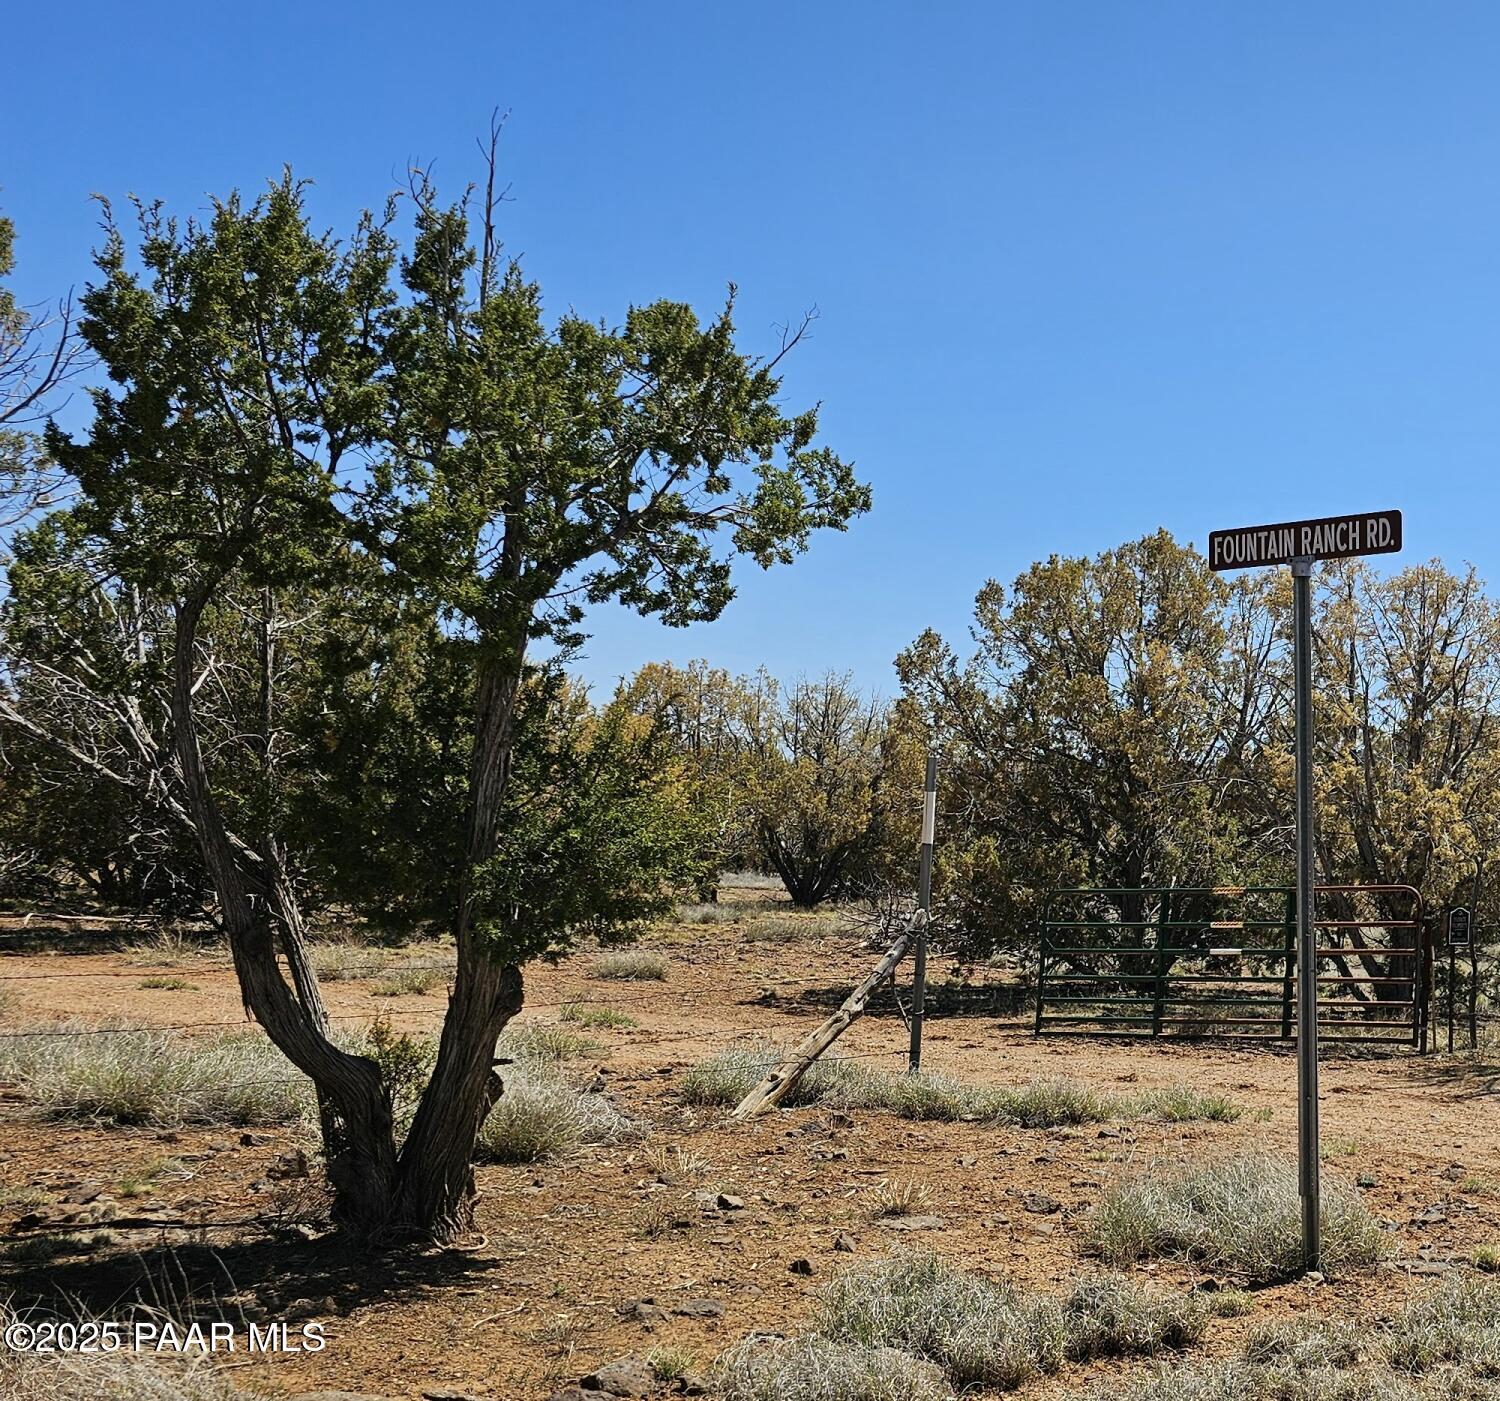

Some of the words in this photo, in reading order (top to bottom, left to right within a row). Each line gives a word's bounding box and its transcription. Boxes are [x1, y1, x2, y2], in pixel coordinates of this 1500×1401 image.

[1214, 528, 1295, 565] FOUNTAIN
[1301, 520, 1360, 556] RANCH
[1366, 517, 1395, 549] RD.
